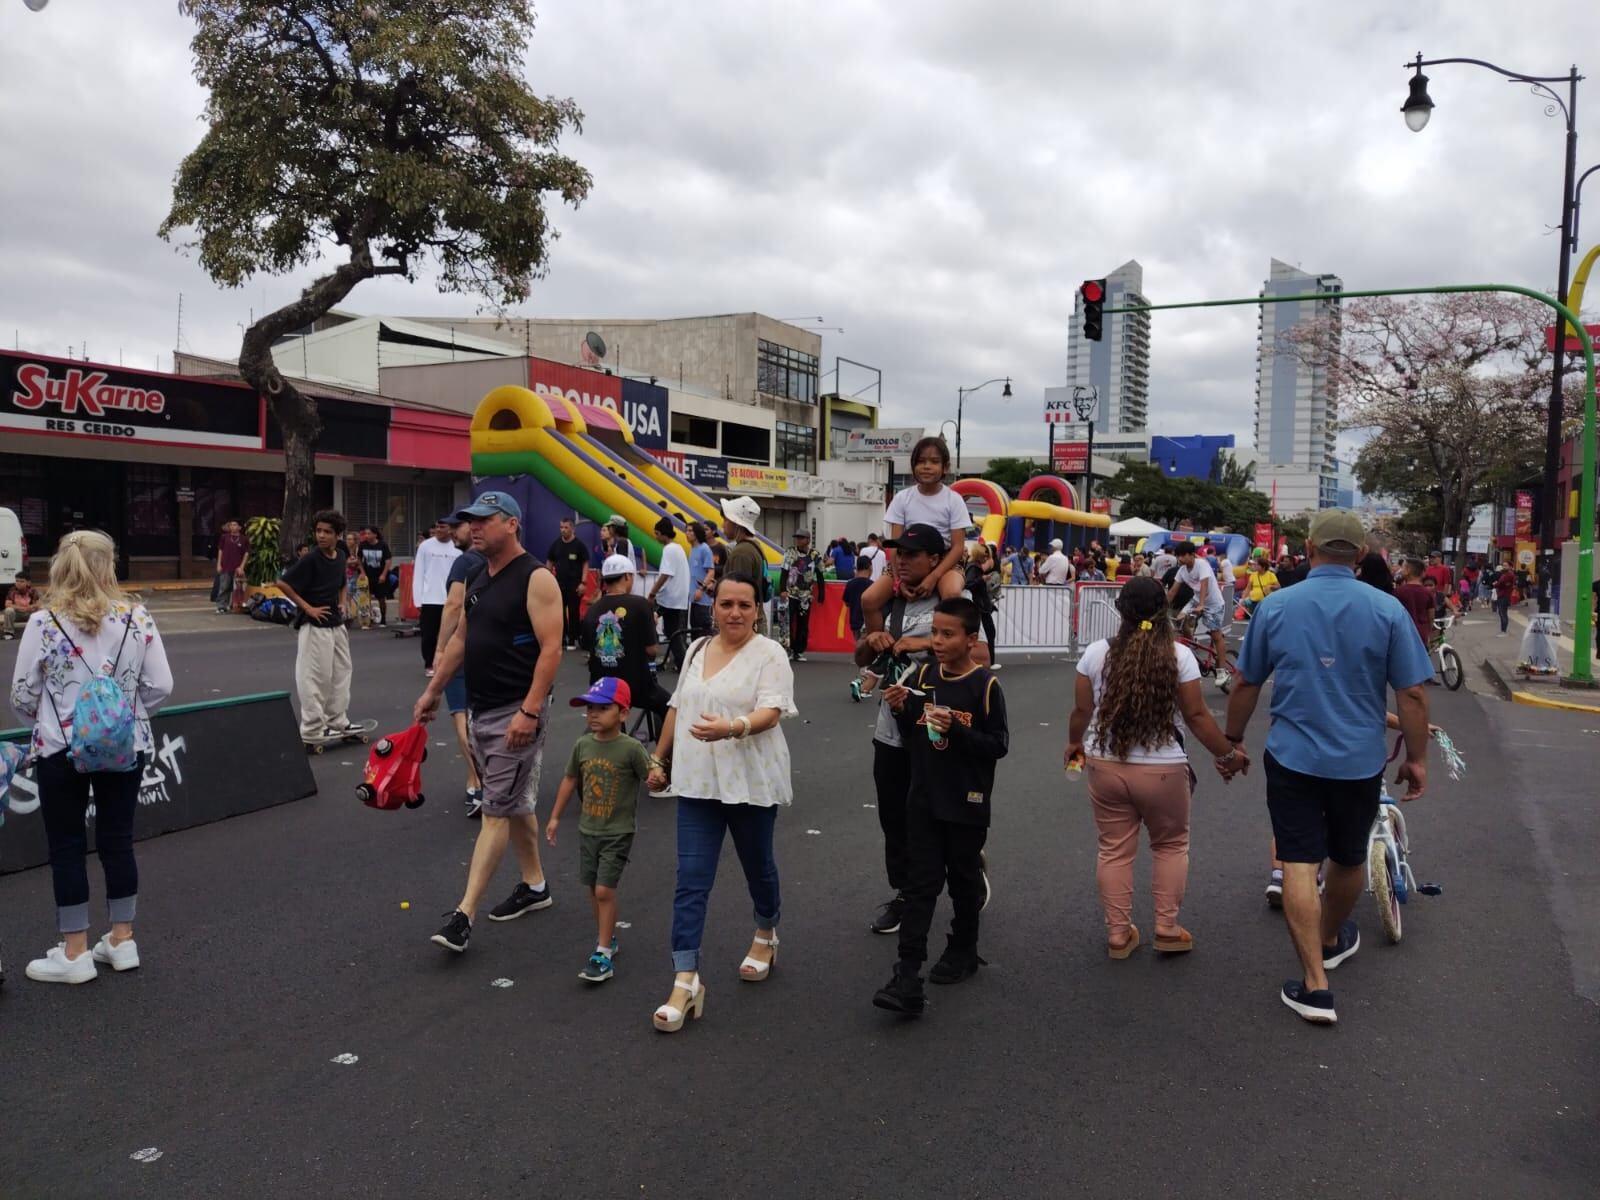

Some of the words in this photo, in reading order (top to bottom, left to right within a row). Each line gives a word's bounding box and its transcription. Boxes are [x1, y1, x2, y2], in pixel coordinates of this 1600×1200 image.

[13, 364, 165, 416] SuKarne
[1046, 400, 1072, 410] KFC
[624, 400, 662, 437] USA
[46, 419, 75, 432] RES
[83, 423, 135, 437] CERDO
[864, 438, 900, 446] TRICOLOR
